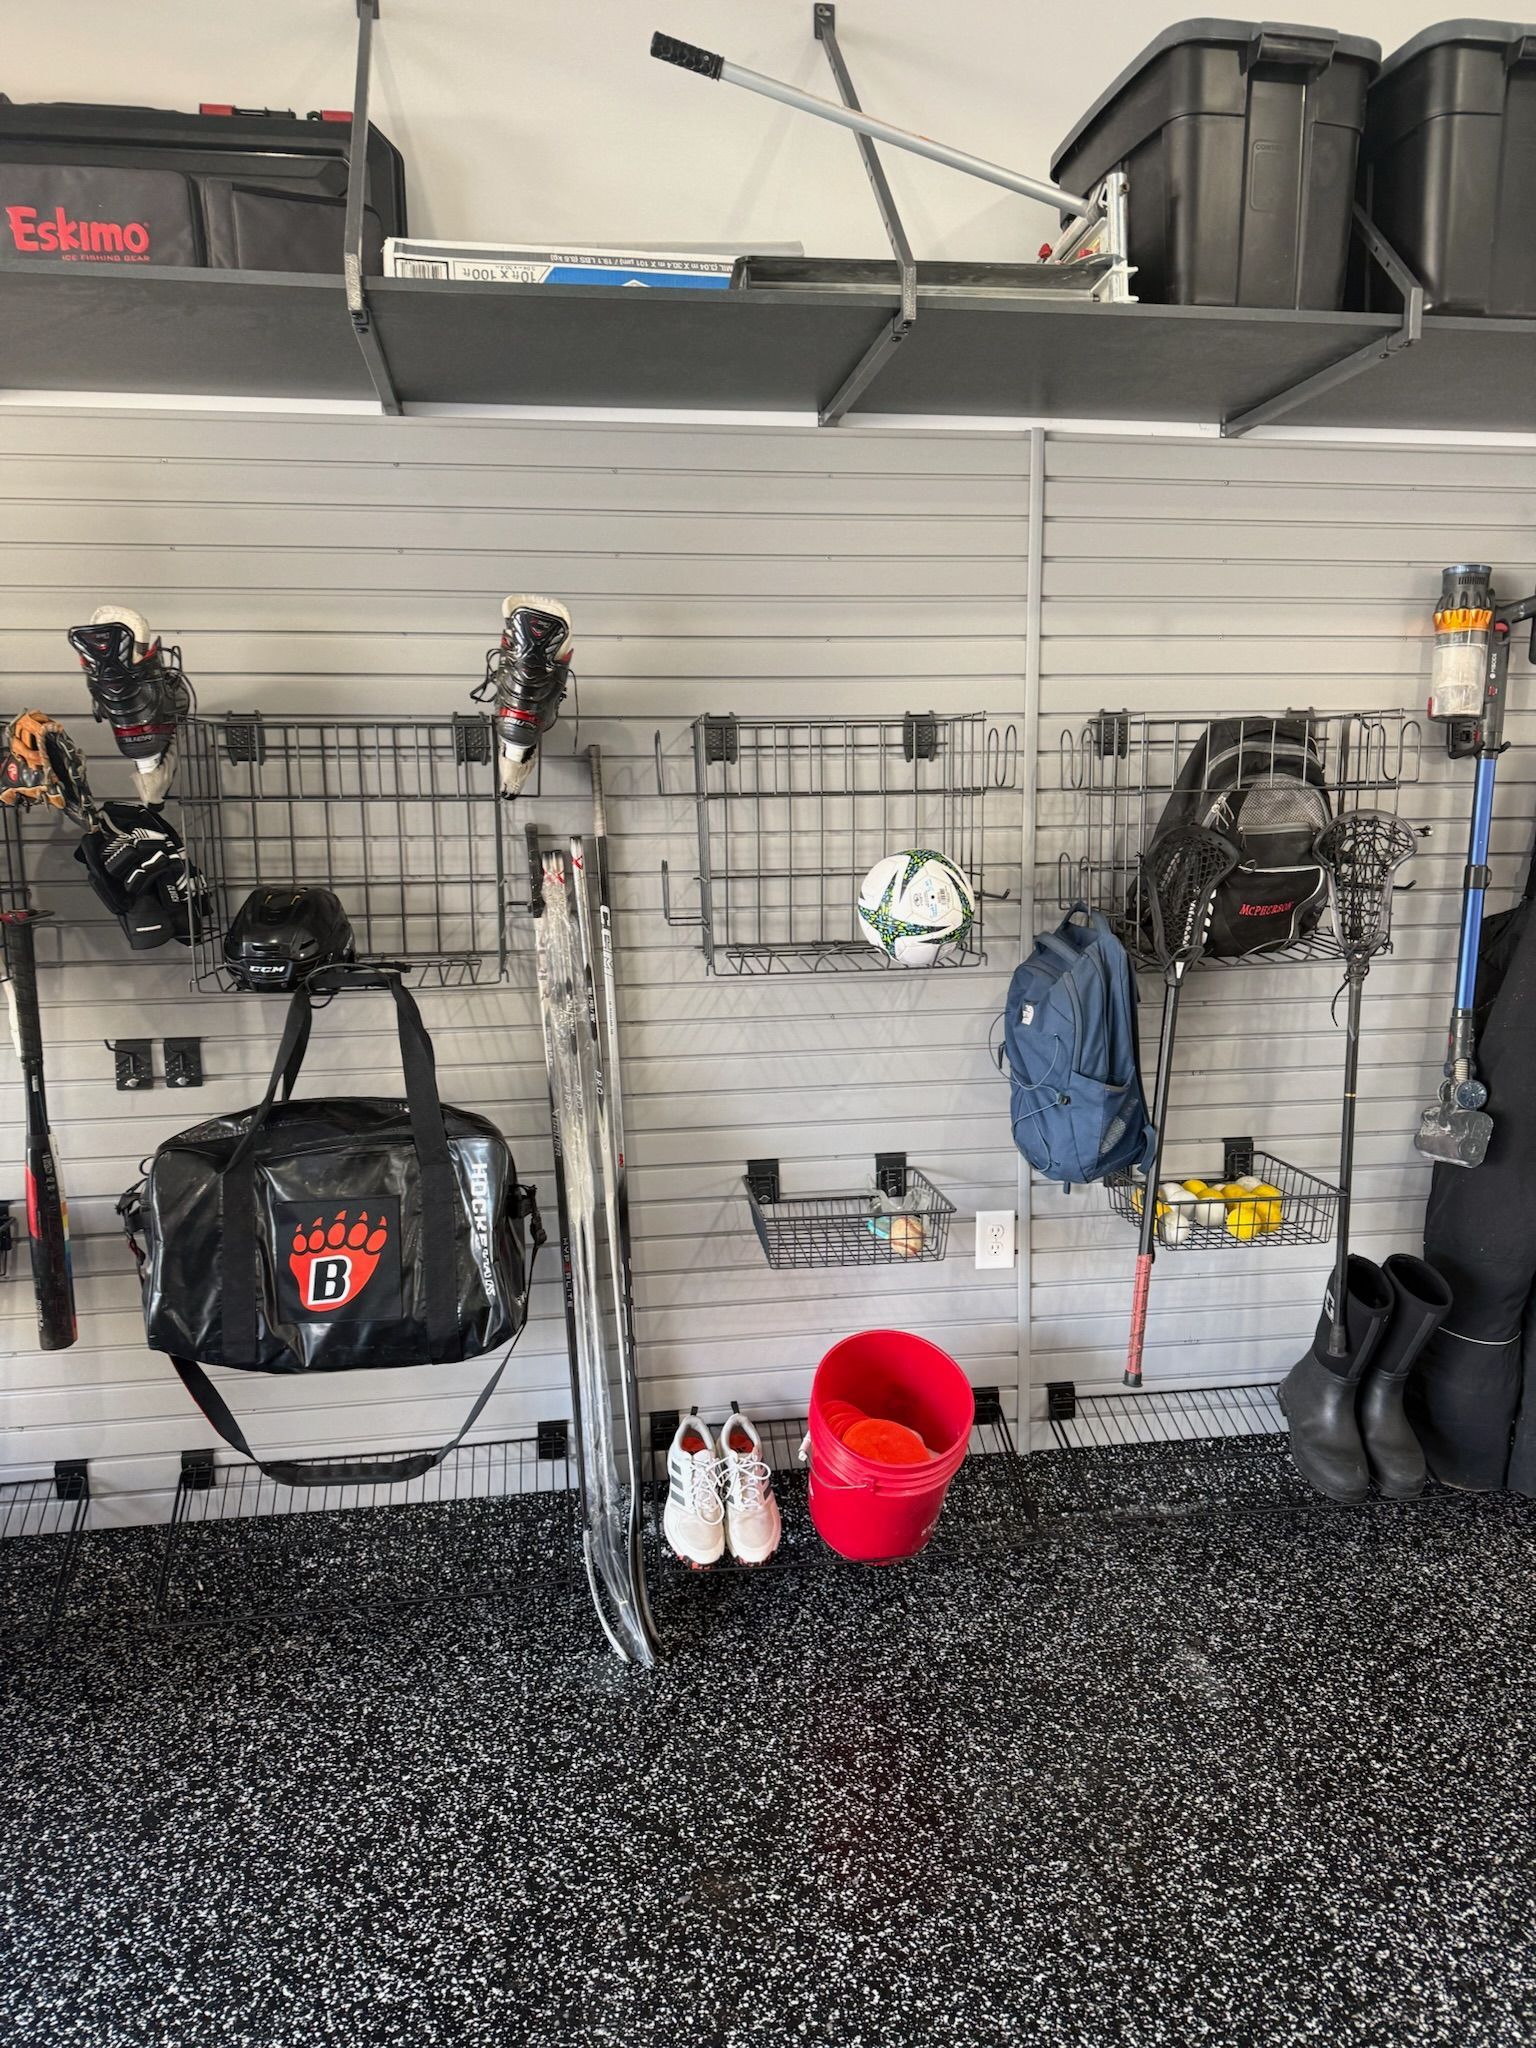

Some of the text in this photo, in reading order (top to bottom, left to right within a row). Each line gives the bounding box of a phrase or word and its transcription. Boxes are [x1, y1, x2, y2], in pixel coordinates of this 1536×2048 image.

[5, 206, 149, 254] Eskimo
[249, 965, 286, 974] CCM
[594, 1070, 604, 1095] PRO
[308, 1255, 351, 1305] B
